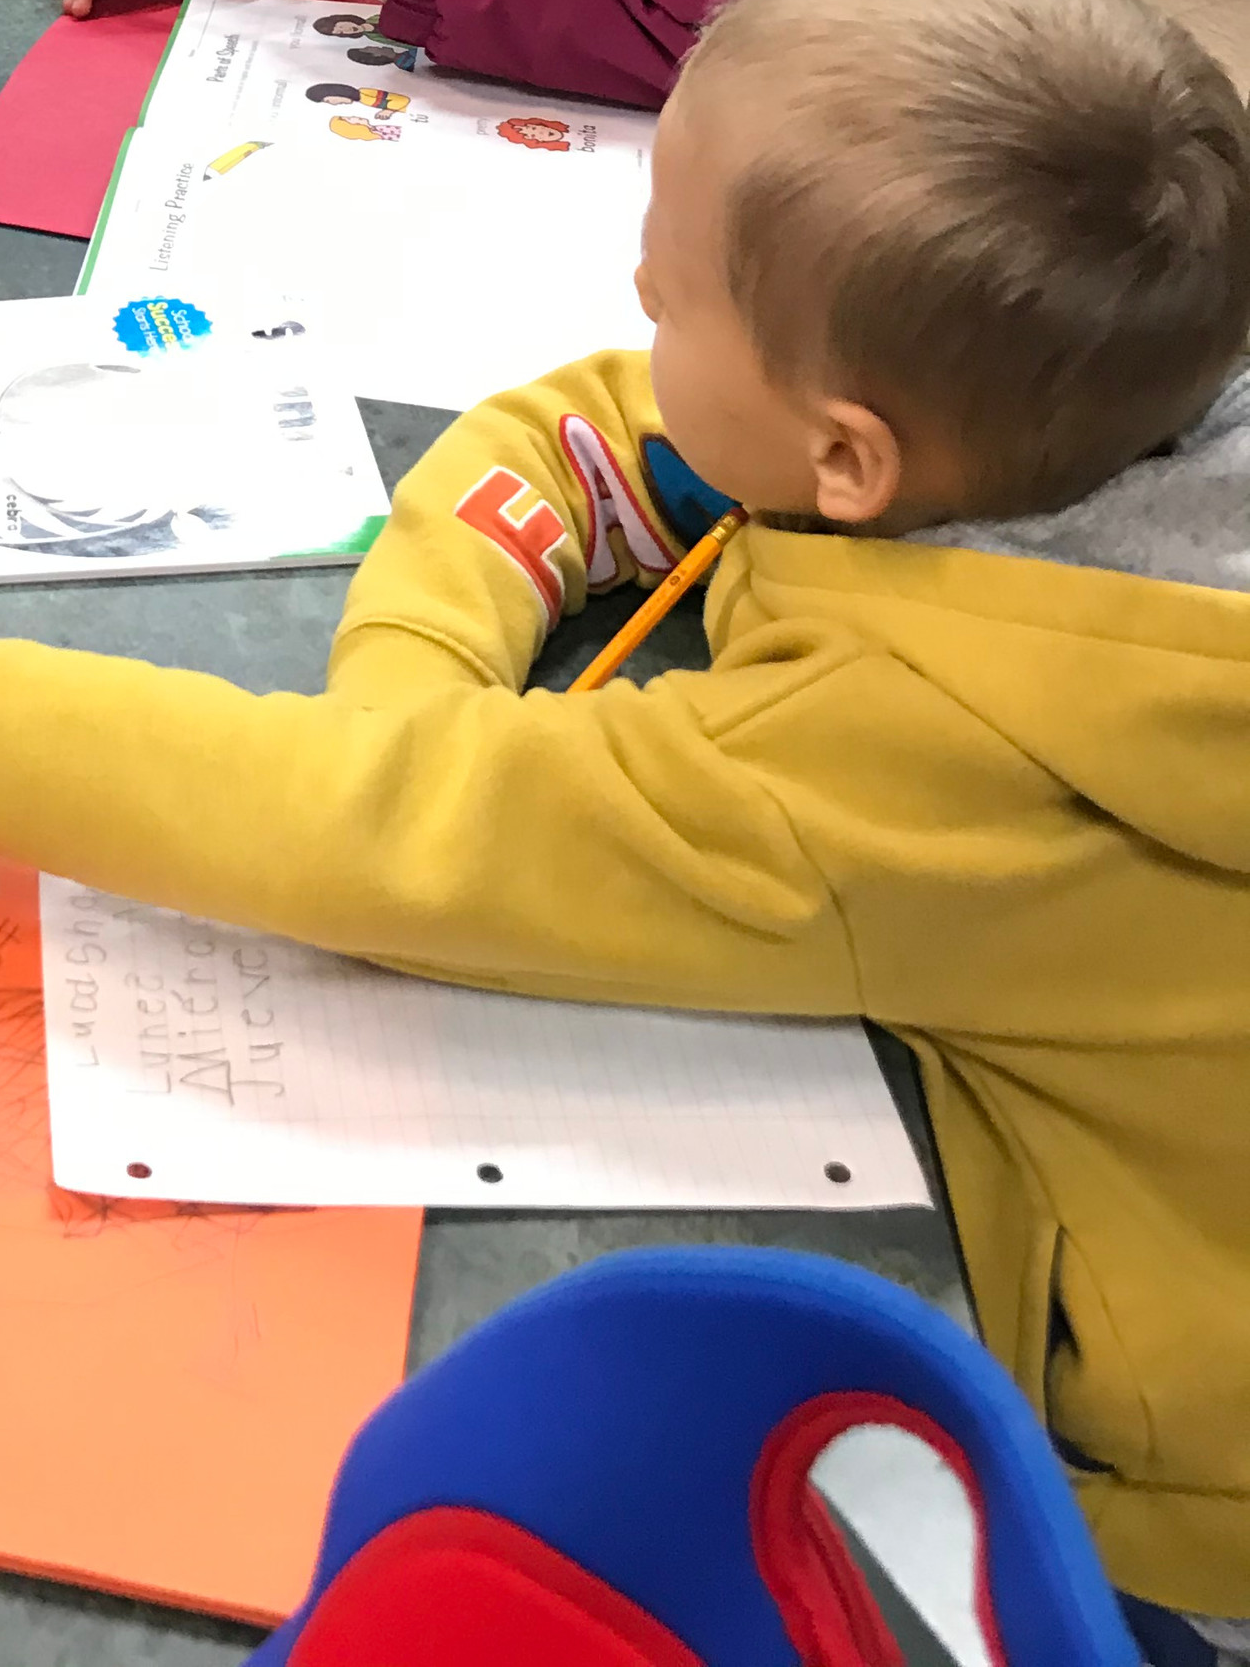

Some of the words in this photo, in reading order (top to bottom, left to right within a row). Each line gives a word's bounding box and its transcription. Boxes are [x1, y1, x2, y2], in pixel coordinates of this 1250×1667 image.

[410, 112, 429, 124] tú
[577, 124, 597, 153] bonita
[164, 162, 194, 209] Practice
[148, 214, 187, 271] Listening
[146, 301, 177, 346] Succe
[6, 494, 22, 532] cebra
